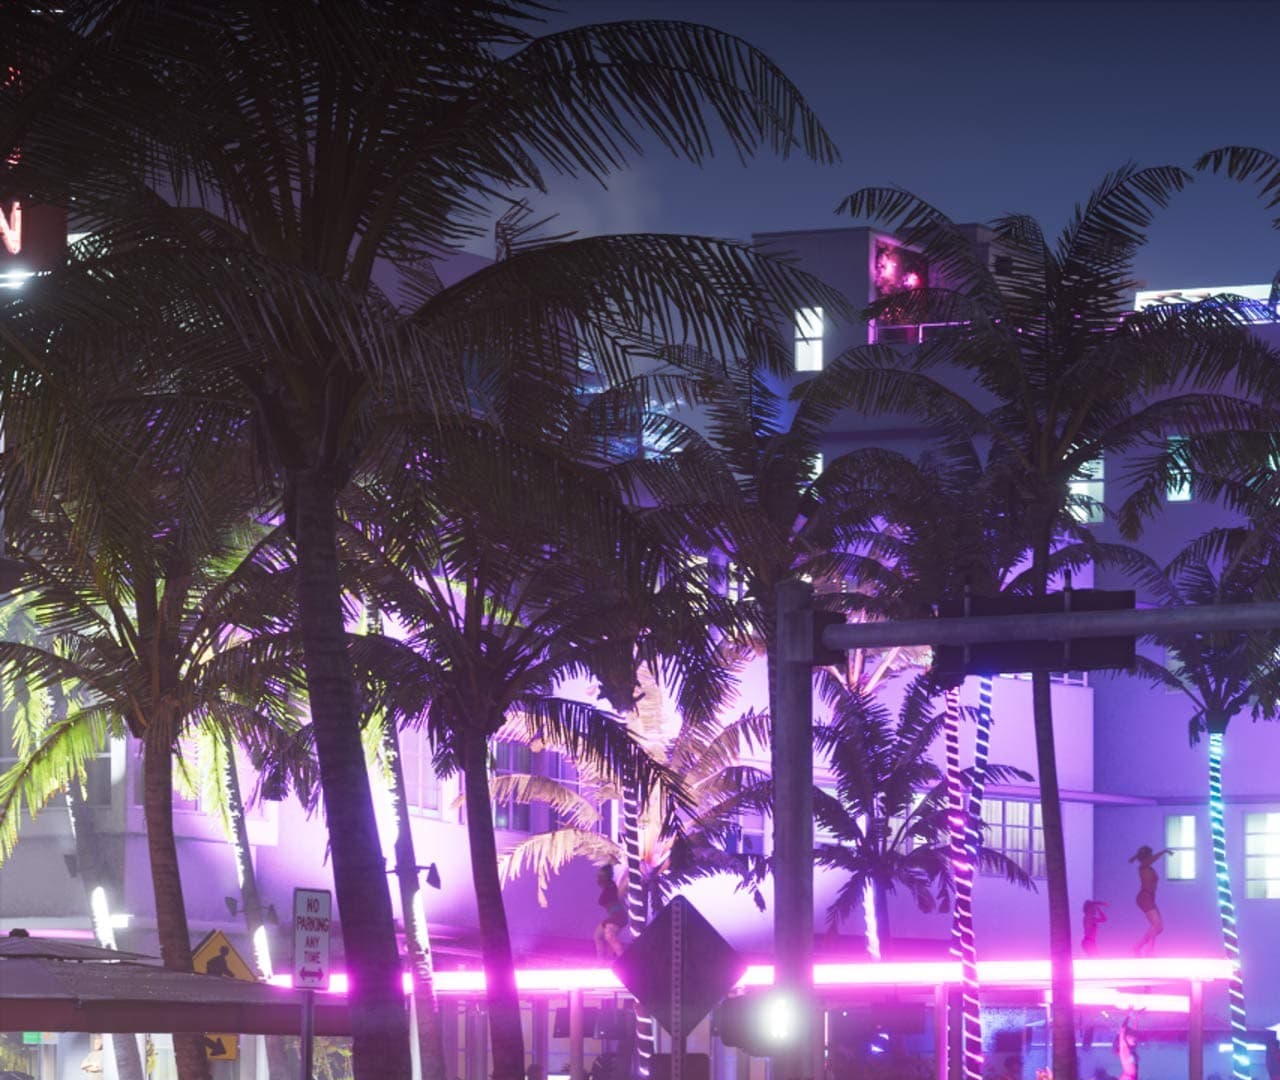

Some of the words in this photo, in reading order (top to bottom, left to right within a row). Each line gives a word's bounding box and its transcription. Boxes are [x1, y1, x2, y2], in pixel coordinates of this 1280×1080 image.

[306, 898, 319, 912] NO
[297, 916, 329, 932] PARKING
[305, 936, 320, 948] ANY
